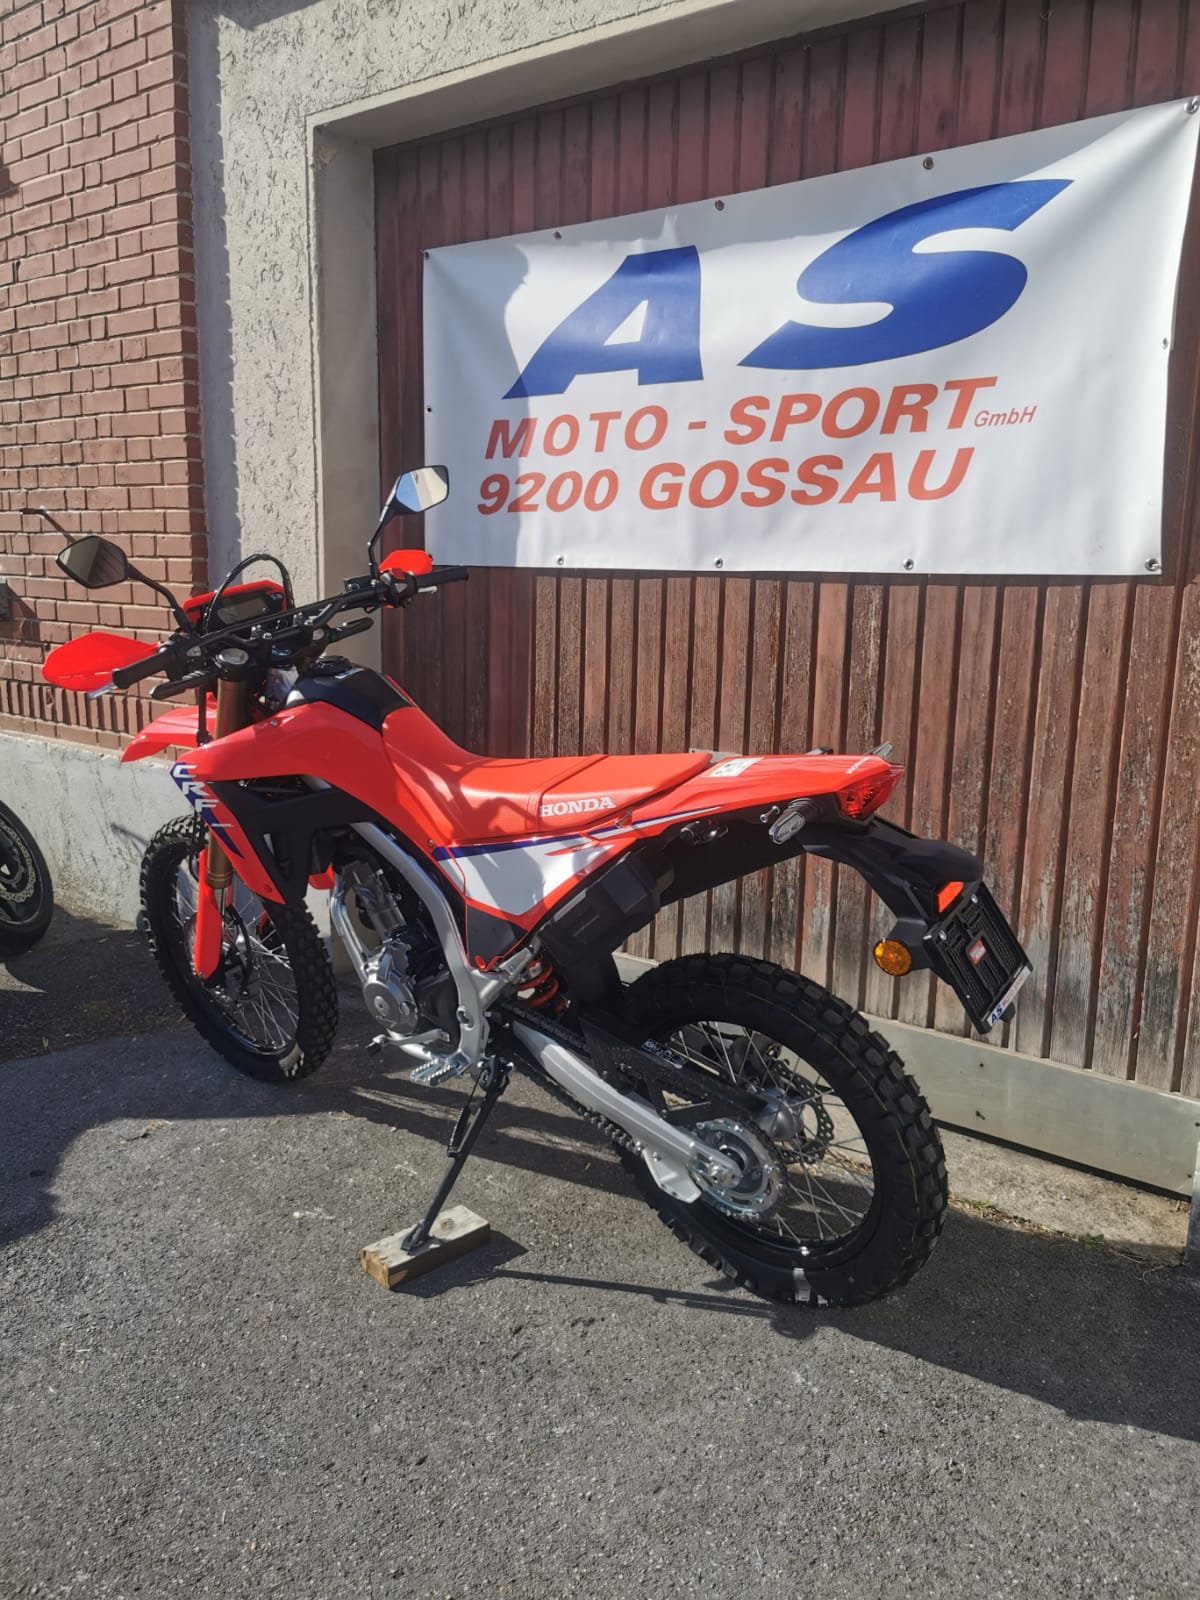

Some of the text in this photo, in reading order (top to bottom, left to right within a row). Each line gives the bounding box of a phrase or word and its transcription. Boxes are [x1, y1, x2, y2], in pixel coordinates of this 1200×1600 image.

[502, 178, 1073, 399] AS
[485, 377, 1037, 460] MOTO - SPORT GmbH
[477, 447, 976, 515] 9200 GOSSAU
[173, 764, 219, 812] CRF
[539, 796, 616, 818] HONDA
